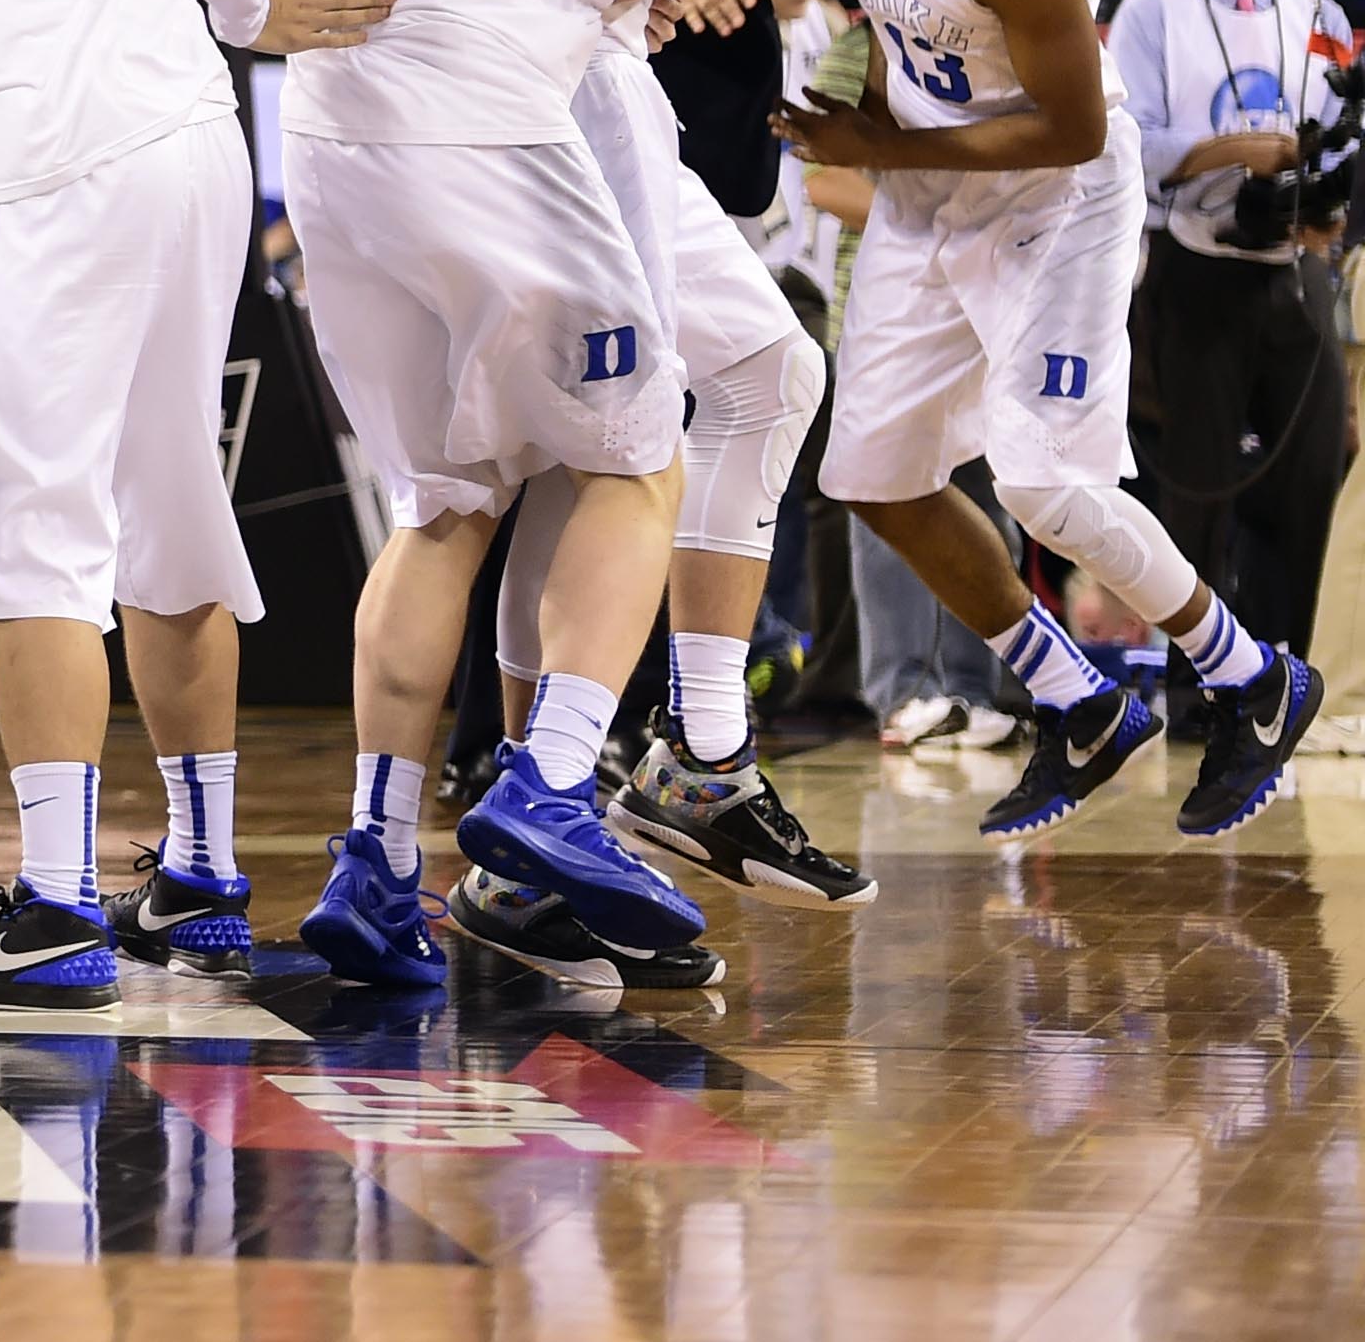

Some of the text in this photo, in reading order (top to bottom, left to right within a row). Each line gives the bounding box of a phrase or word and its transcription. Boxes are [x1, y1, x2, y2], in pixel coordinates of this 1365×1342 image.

[884, 21, 973, 105] 13
[581, 325, 637, 383] D
[1039, 352, 1088, 400] D
[263, 1074, 644, 1155] 2015
